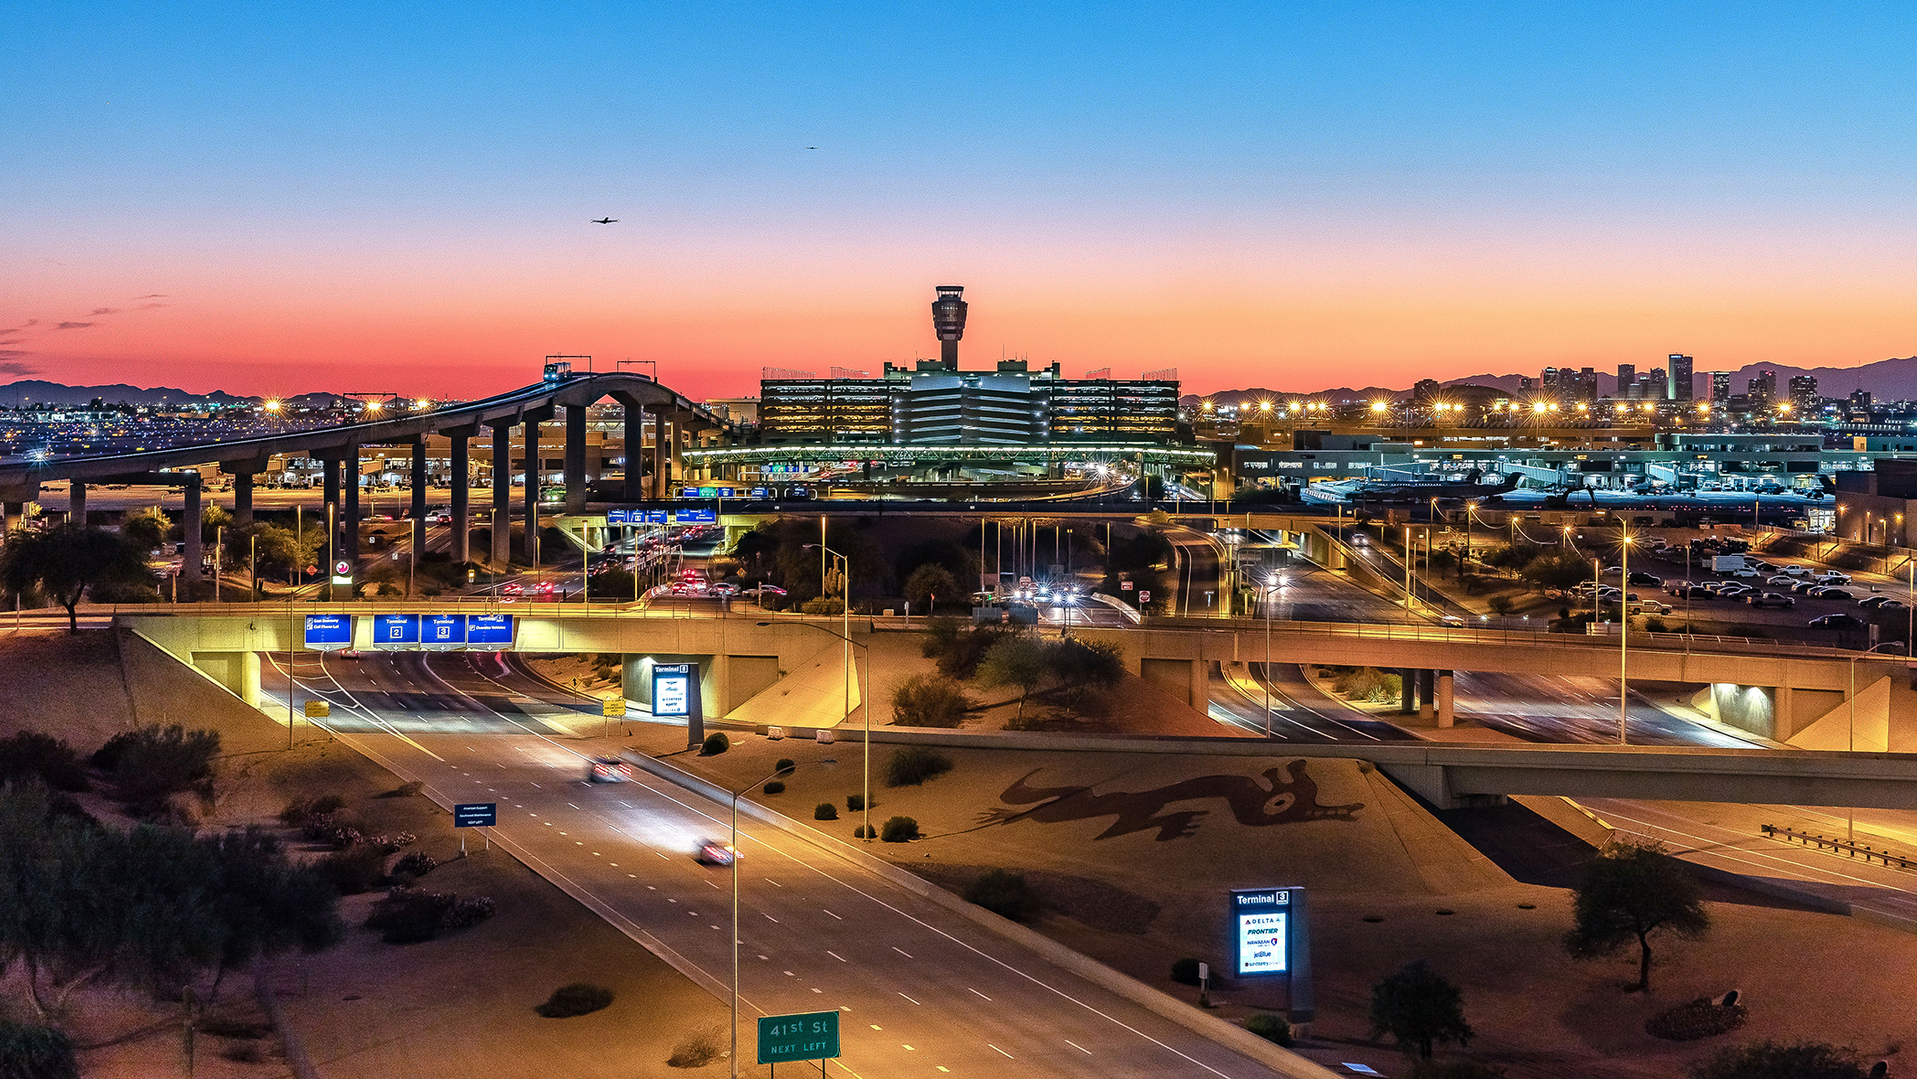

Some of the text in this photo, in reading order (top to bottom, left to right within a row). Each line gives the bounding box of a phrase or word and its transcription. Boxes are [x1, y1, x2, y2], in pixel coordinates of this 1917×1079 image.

[394, 628, 399, 636] 2
[441, 627, 446, 635] 3
[1237, 894, 1274, 904] Terminal
[1280, 892, 1285, 900] 3
[770, 1021, 828, 1036] 41st St
[771, 1041, 827, 1054] NEXT LEFT
